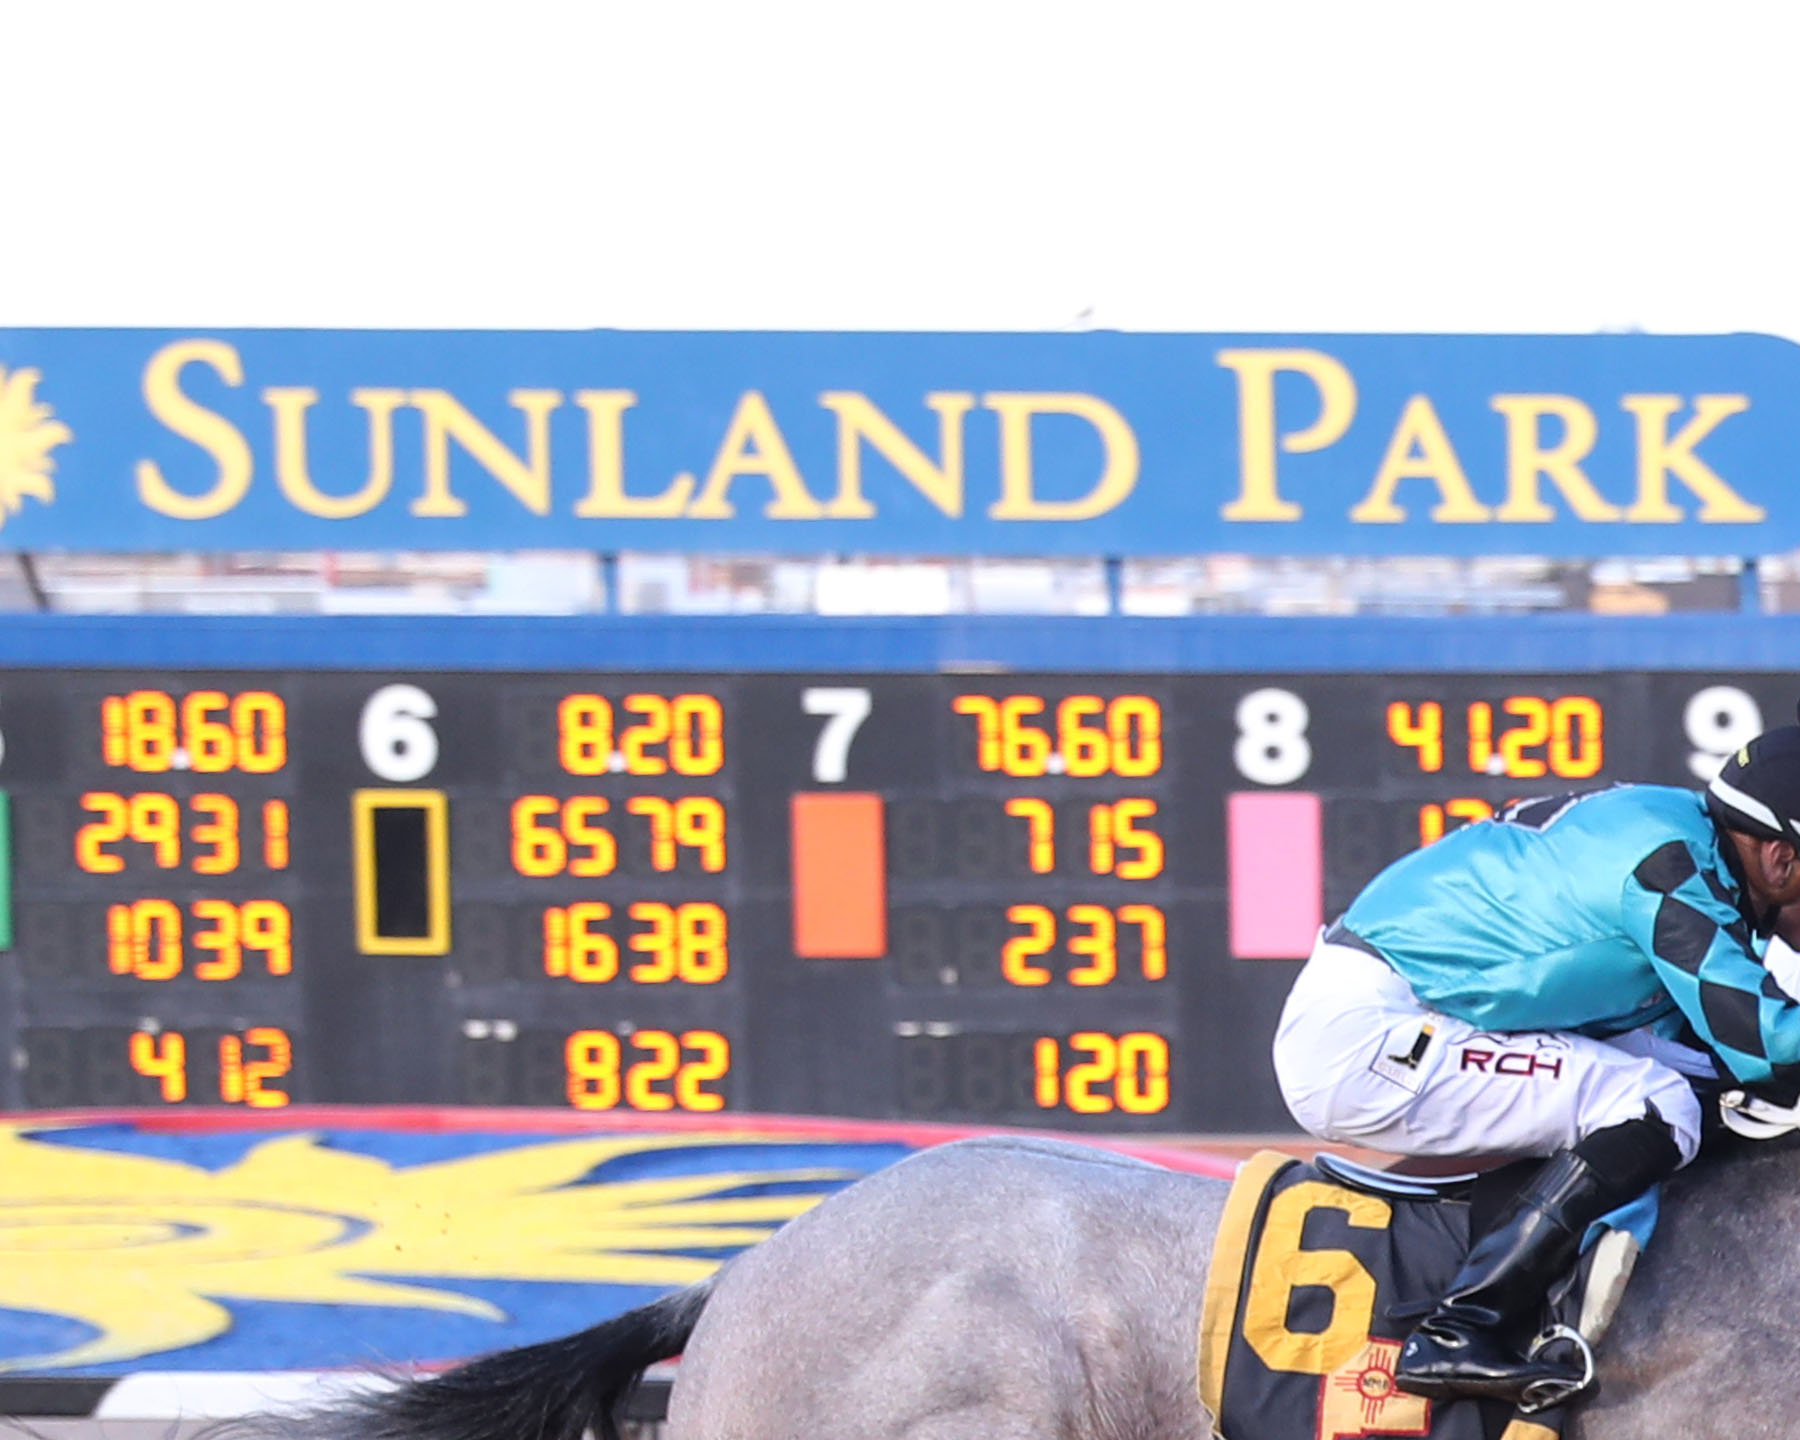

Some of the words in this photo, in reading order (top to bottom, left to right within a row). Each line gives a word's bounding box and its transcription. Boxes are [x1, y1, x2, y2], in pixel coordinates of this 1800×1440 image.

[139, 341, 1139, 519] SUNLAND
[1219, 350, 1763, 523] PARK
[102, 691, 288, 773] 18.60
[361, 685, 438, 782] 6
[558, 694, 724, 776] 8.20
[803, 688, 870, 782] 7
[953, 695, 1162, 777] 76.60
[1234, 688, 1310, 784] 8
[1685, 687, 1762, 780] 9
[1035, 1032, 1171, 1114] 120
[1242, 1179, 1394, 1374] 6
